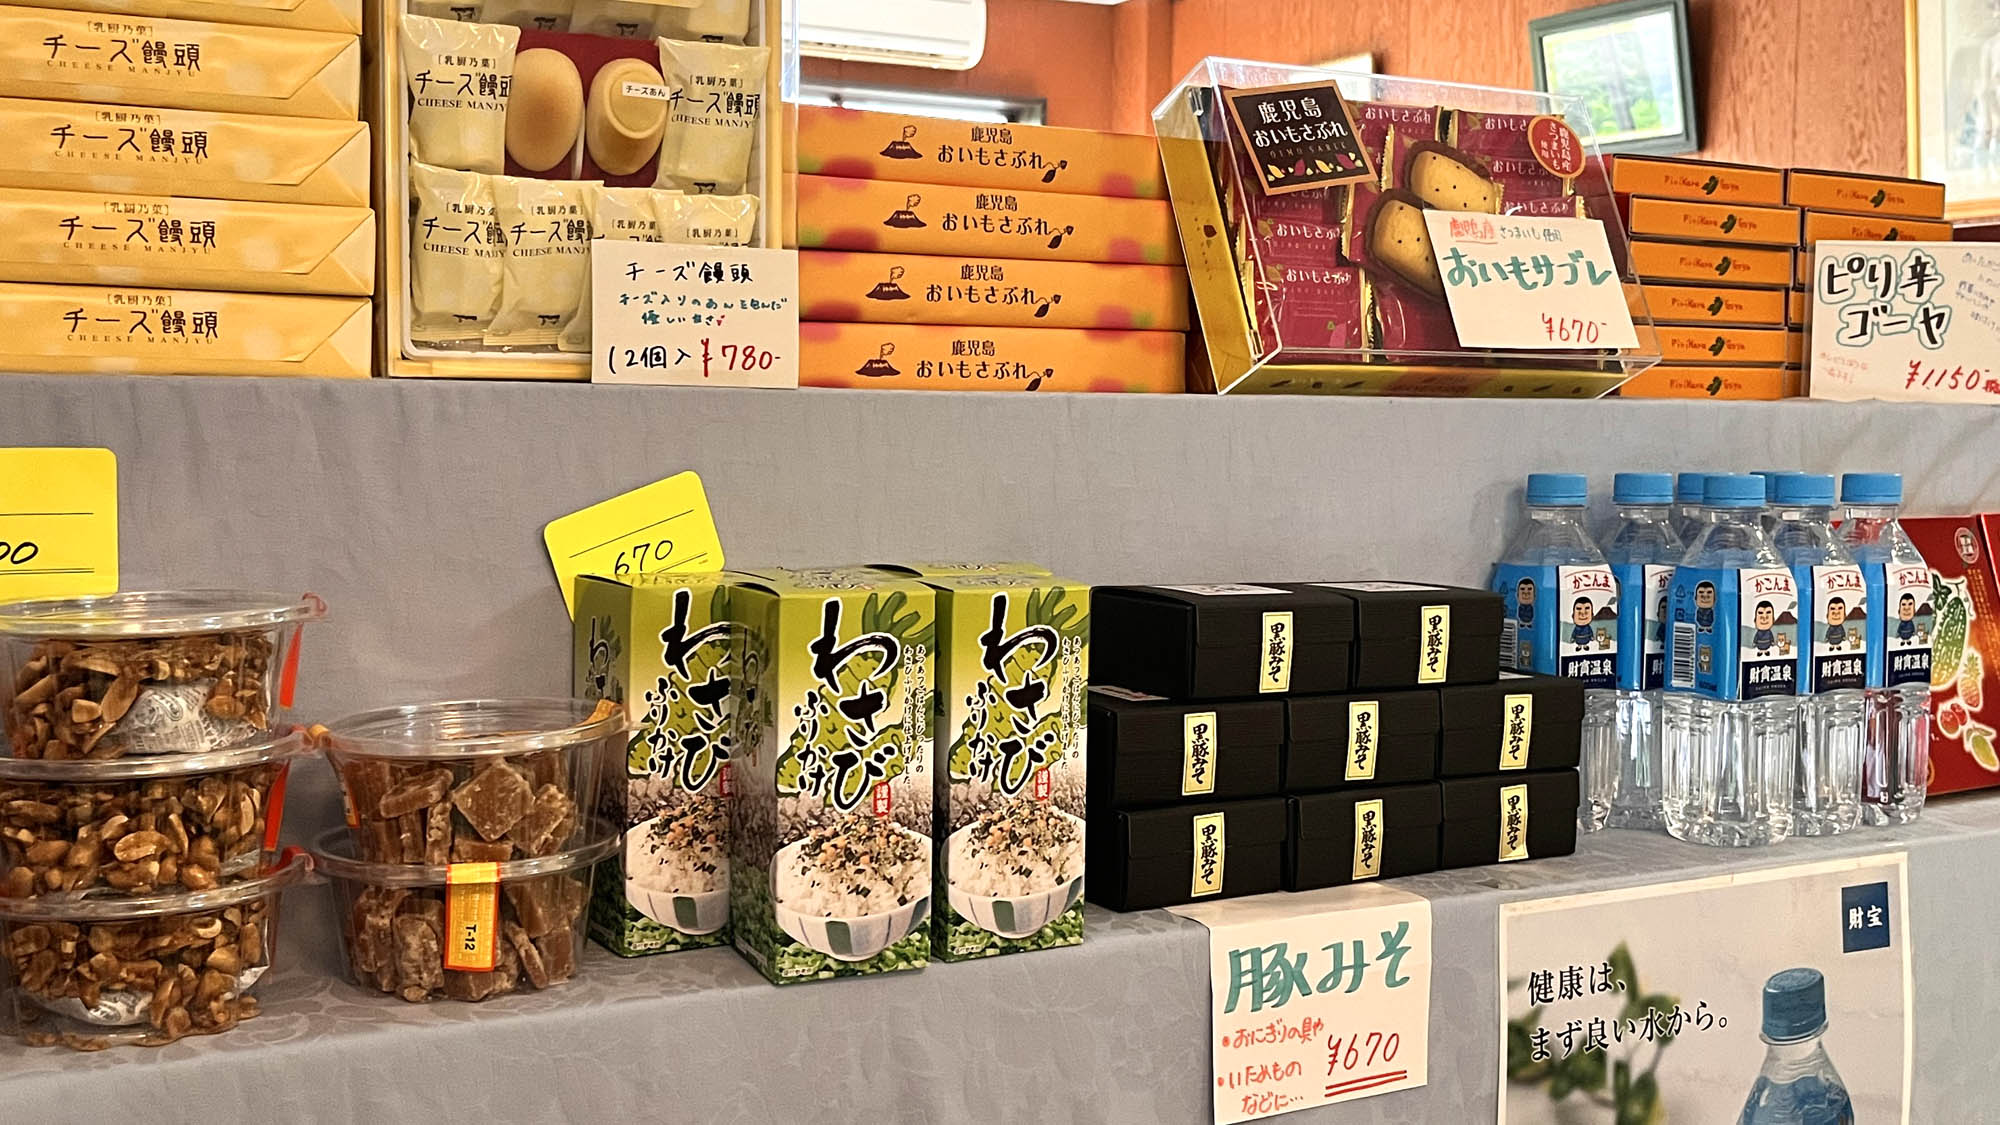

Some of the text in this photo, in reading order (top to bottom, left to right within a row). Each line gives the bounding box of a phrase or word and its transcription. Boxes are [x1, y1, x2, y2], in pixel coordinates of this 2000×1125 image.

[43, 35, 200, 72] チーズ饅頭
[46, 60, 196, 77] CHEESE MANJYU
[417, 98, 463, 109] CHEESE
[1258, 97, 1322, 124] 鹿児島
[672, 114, 711, 126] CHEESE
[1253, 120, 1349, 148] おいもさぶれ
[50, 124, 208, 159] チーズ饅頭
[971, 126, 1013, 144] 鹿児島
[54, 150, 204, 165] CHEESE MANJYU
[937, 145, 1044, 170] おいもさぶれ
[975, 194, 1018, 211] 鹿児島
[59, 215, 216, 249] チーズ饅頭
[942, 213, 1050, 236] おいもさぶれ
[63, 241, 212, 255] CHEESE MANJYU
[423, 242, 469, 256] CHEESE
[513, 246, 552, 257] CHEESE
[626, 261, 753, 284] チーズ饅頭
[960, 264, 1004, 281] 鹿児島
[1827, 255, 1939, 299] ピリ辛
[926, 284, 1036, 305] おいもさぶれ
[63, 308, 218, 339] チーズ饅頭
[1847, 304, 1946, 345] ゴーヤ
[67, 334, 214, 345] CHEESE MANJYU
[951, 340, 996, 356] 鹿児島
[916, 360, 1027, 380] おいもさぶれ
[614, 540, 673, 574] 670
[1572, 574, 1611, 589] かこんま
[1755, 577, 1791, 592] かこんま
[1827, 573, 1862, 589] かこんま
[1898, 571, 1930, 585] かこんま
[1268, 621, 1286, 682] 黒豚みそ
[1426, 614, 1444, 673] 黒豚みそ
[810, 598, 899, 812] わさび
[981, 594, 1058, 796] わさび
[645, 677, 678, 779] ふりかけ
[965, 681, 996, 784] ふりかけ
[1354, 711, 1373, 770] 黒豚みそ
[1509, 703, 1528, 760] 黒豚みそ
[795, 691, 829, 797] ふりかけ
[1191, 723, 1210, 785] 黒豚みそ
[1505, 794, 1523, 851] 黒豚みそ
[1359, 809, 1377, 868] 黒豚みそ
[1200, 823, 1218, 885] 黒豚みそ
[1848, 905, 1883, 930] 財宝
[464, 924, 477, 951] T-12
[1224, 921, 1412, 1014] 豚みそ
[1528, 962, 1626, 1007] 健康は、
[1233, 1016, 1324, 1049] おにぎりの具や
[1529, 1000, 1728, 1062] まず良い水から。
[1327, 1032, 1400, 1076] ¥670
[1228, 1061, 1302, 1089] いためもの
